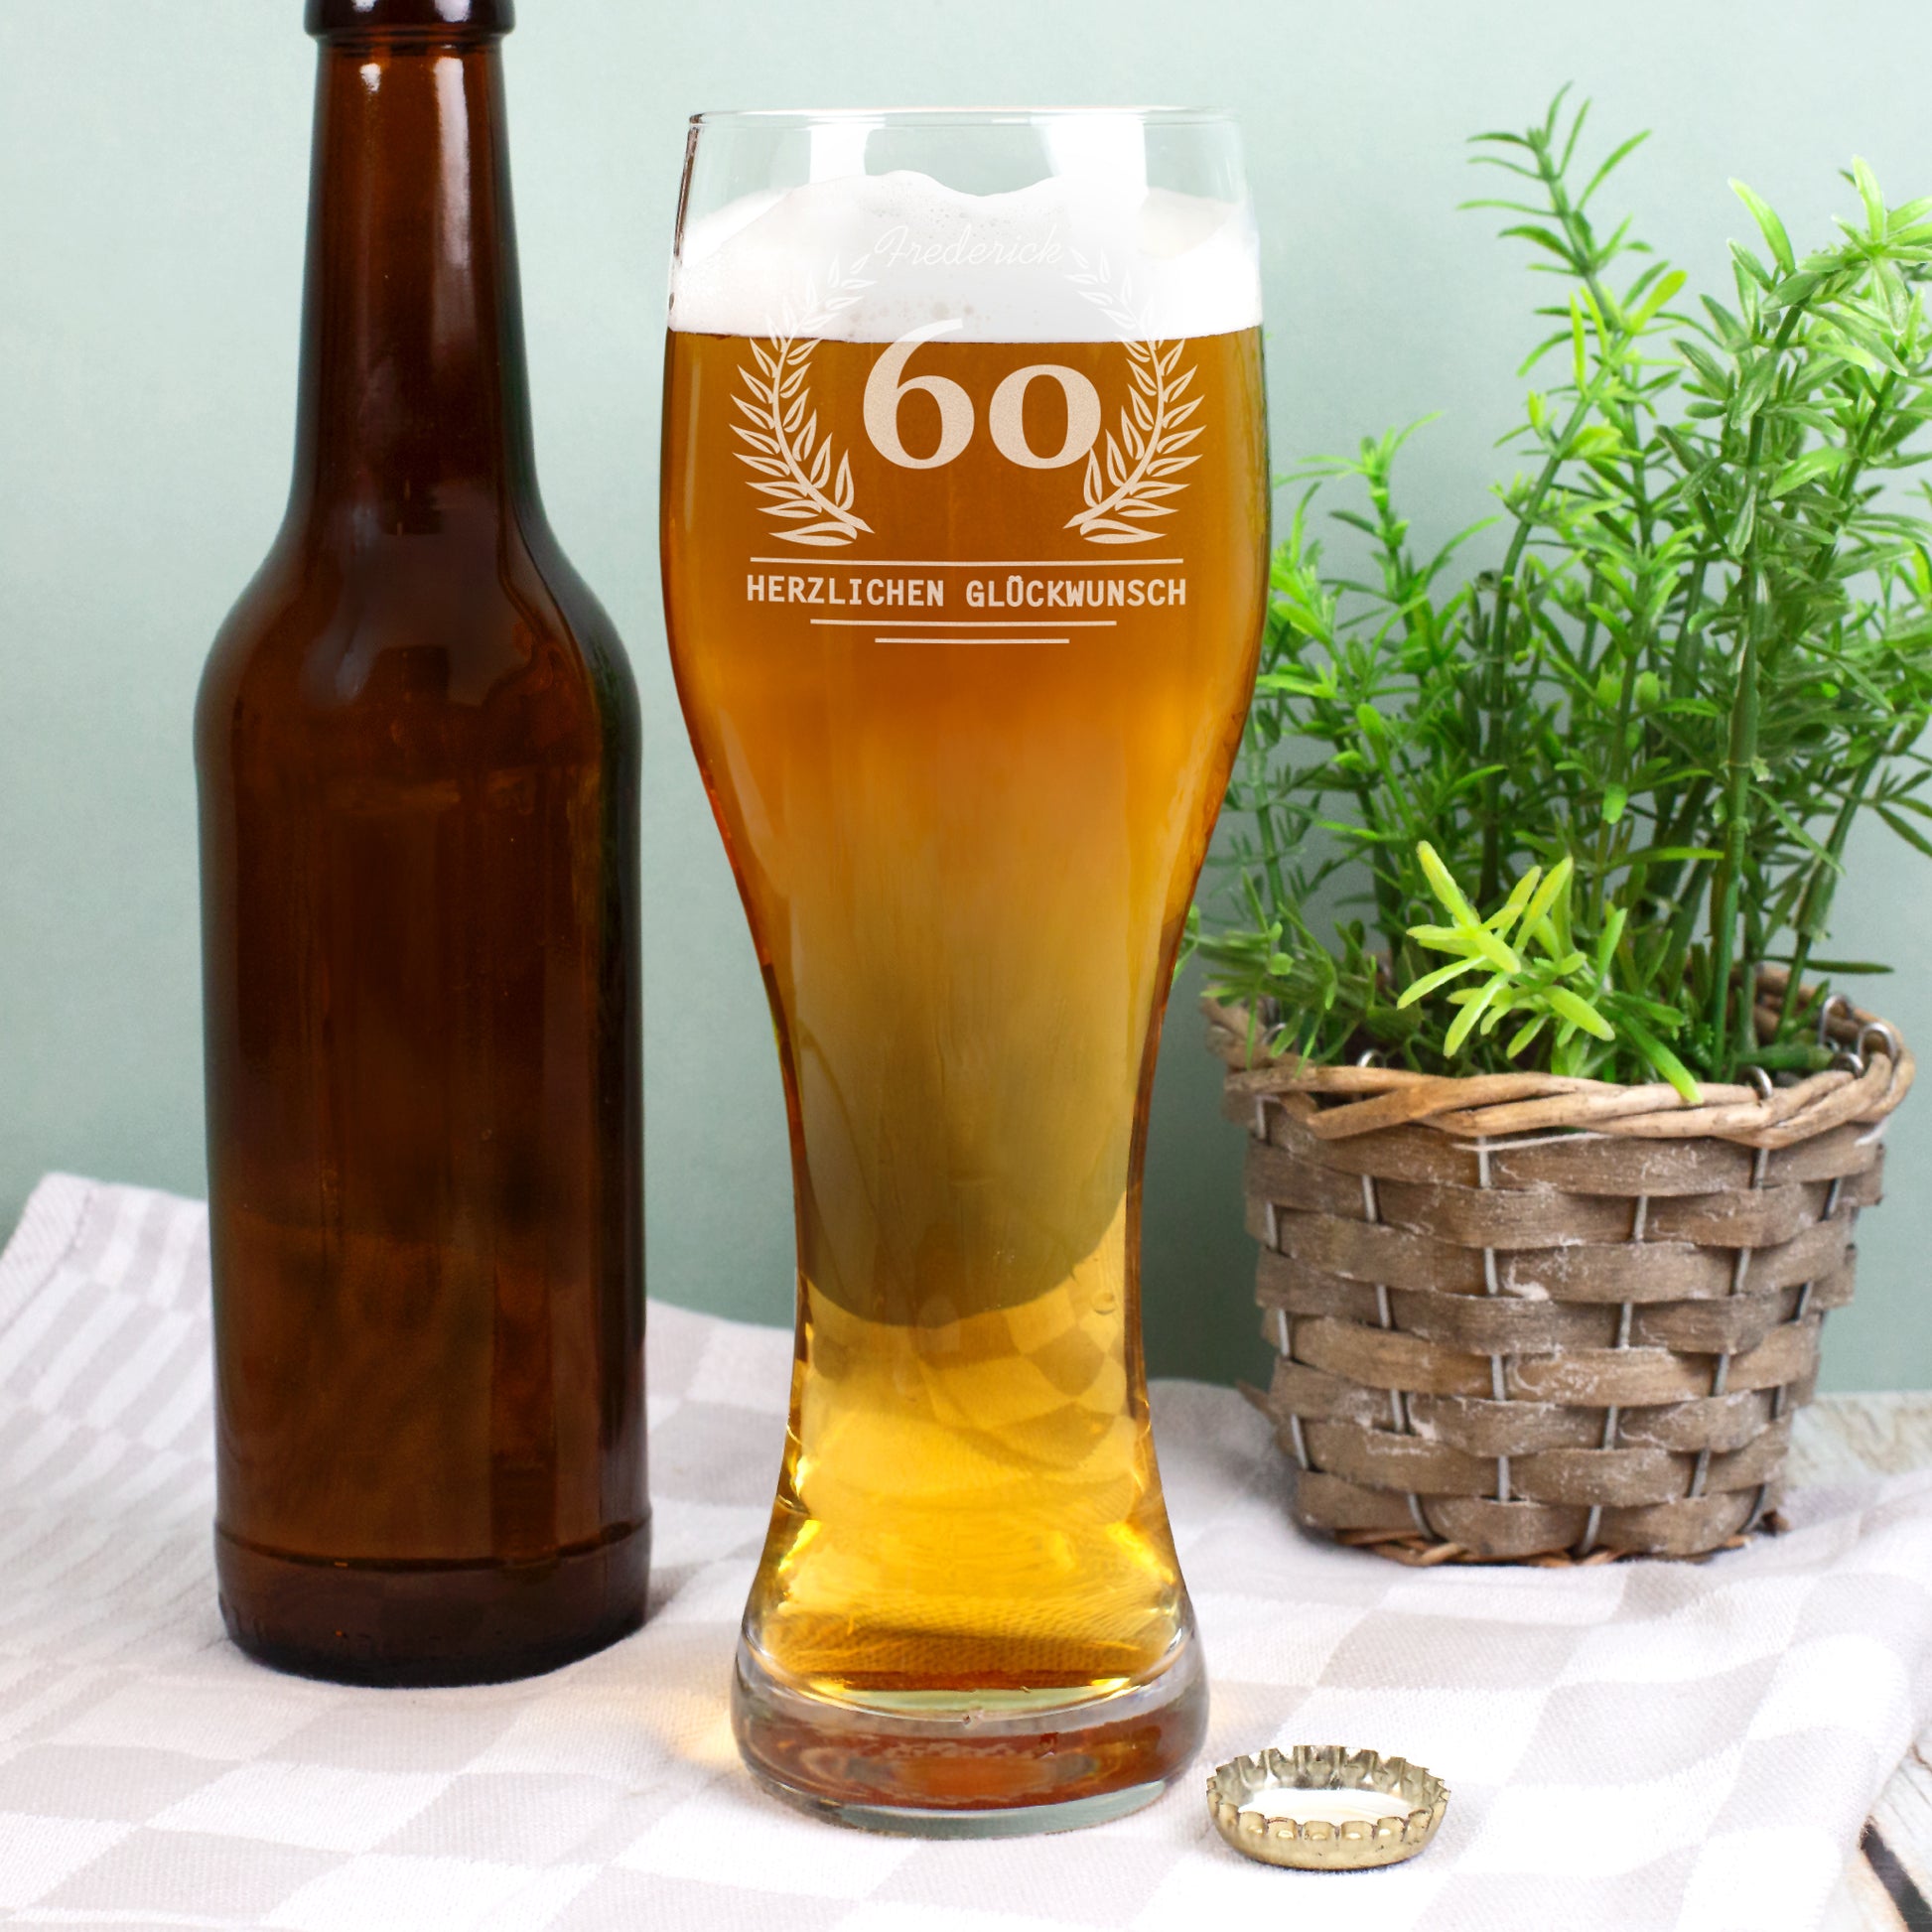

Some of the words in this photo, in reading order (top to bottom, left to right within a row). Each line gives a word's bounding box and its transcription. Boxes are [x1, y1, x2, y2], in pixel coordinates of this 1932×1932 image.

[874, 223, 1064, 268] Frederick
[863, 319, 1102, 470] 60
[747, 574, 944, 607] HERZLICHEN
